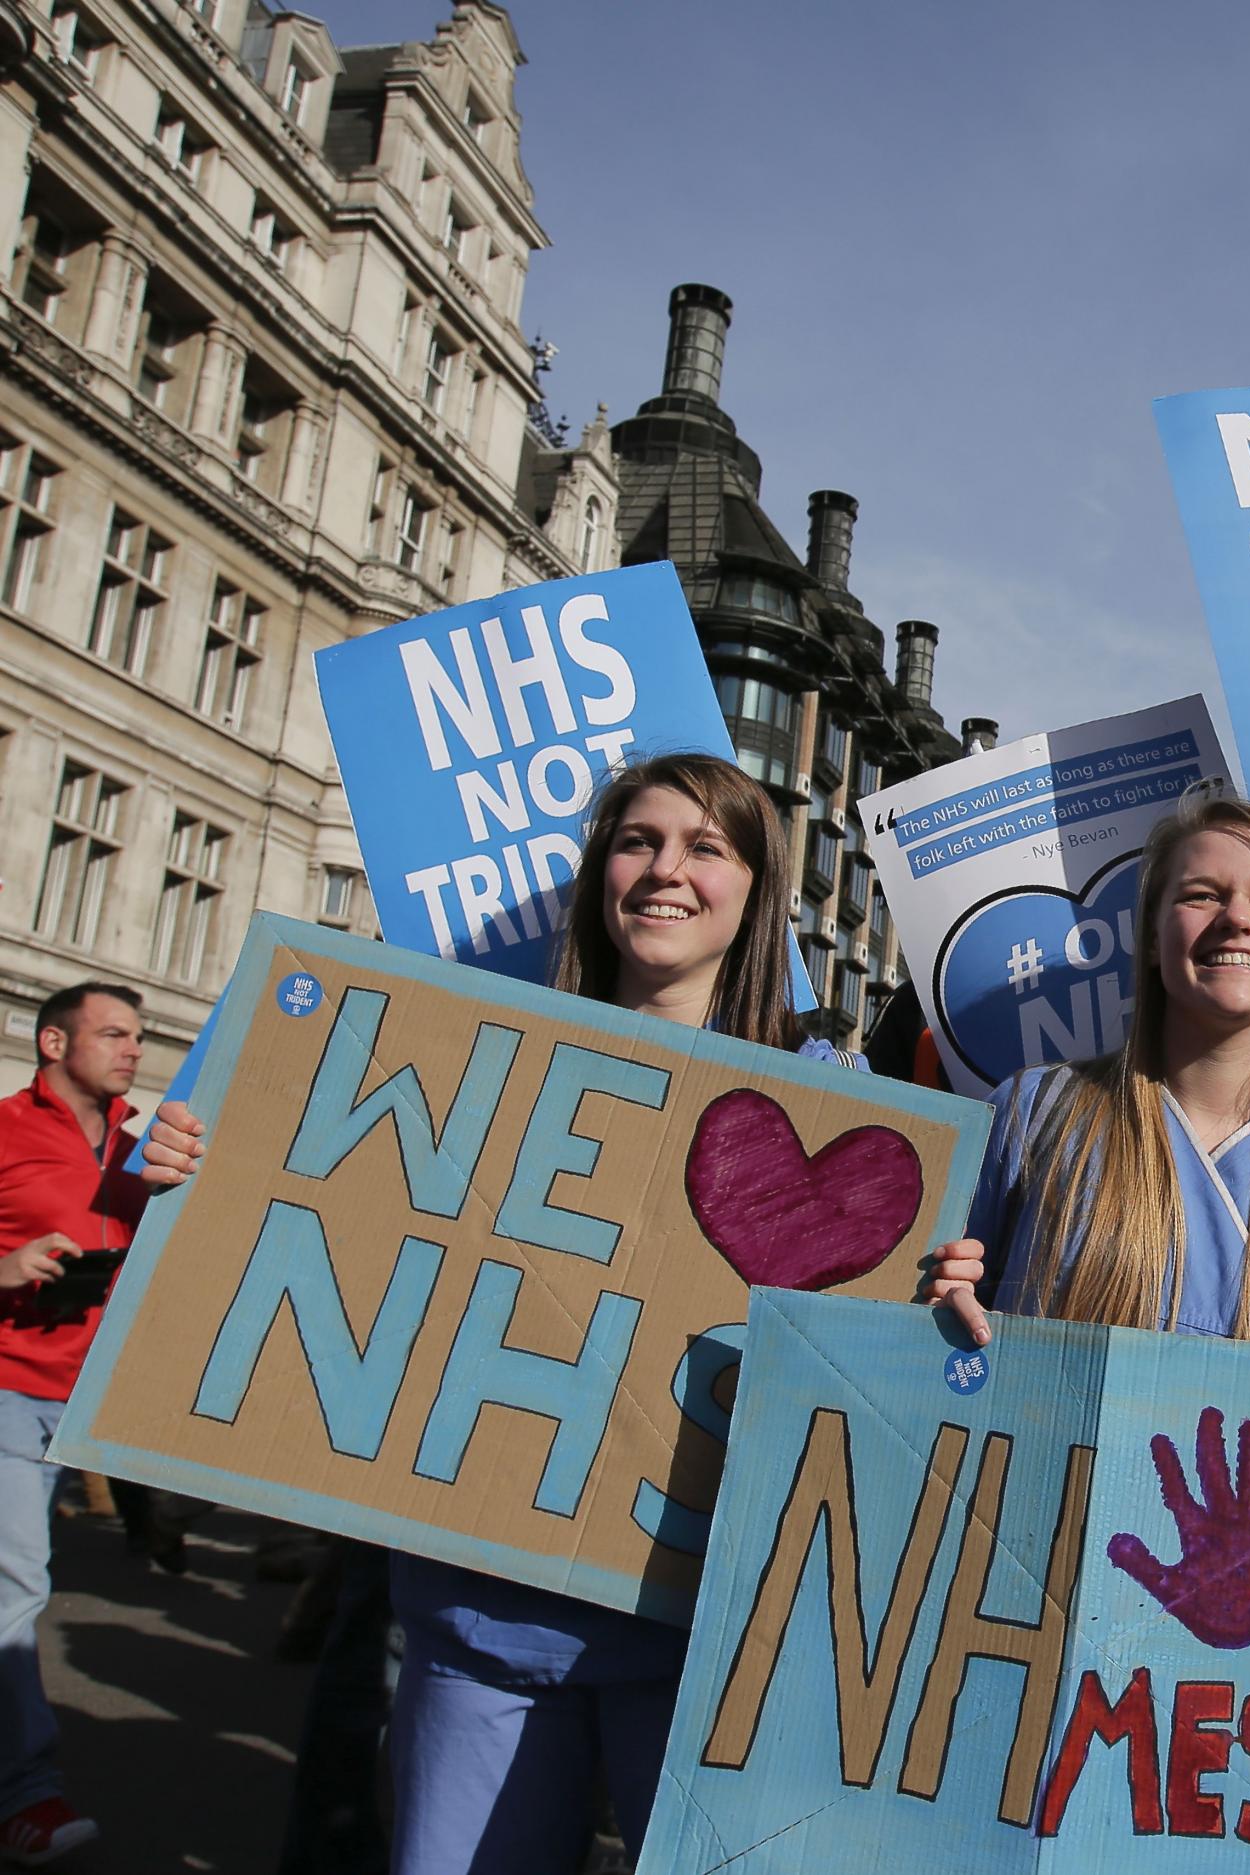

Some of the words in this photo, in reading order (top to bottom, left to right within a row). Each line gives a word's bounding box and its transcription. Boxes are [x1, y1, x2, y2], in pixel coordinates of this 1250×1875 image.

[400, 593, 637, 771] NHS
[455, 728, 635, 843] NOT
[914, 850, 946, 870] folk
[947, 835, 976, 856] left
[978, 822, 1016, 843] with
[1019, 812, 1047, 830] the
[1050, 800, 1089, 821] faith
[1093, 796, 1111, 810] to
[1114, 785, 1154, 805] fight
[1157, 778, 1181, 793] for
[933, 801, 968, 824] NHS
[970, 789, 1000, 810] will
[1003, 781, 1032, 799] last
[1035, 774, 1053, 789] as
[1056, 766, 1094, 784] long
[1099, 758, 1115, 773] as
[1117, 748, 1161, 768] there
[1165, 741, 1190, 757] are
[1032, 841, 1064, 861] Nye
[1067, 825, 1119, 848] Bevan
[405, 832, 583, 961] TRID
[1065, 908, 1136, 970] OU
[286, 993, 314, 1007] TRIDENT
[294, 977, 314, 991] NHS
[294, 989, 309, 997] NOT
[1019, 971, 1137, 1067] NH
[284, 985, 672, 1267] WE
[190, 1198, 748, 1555] NHS
